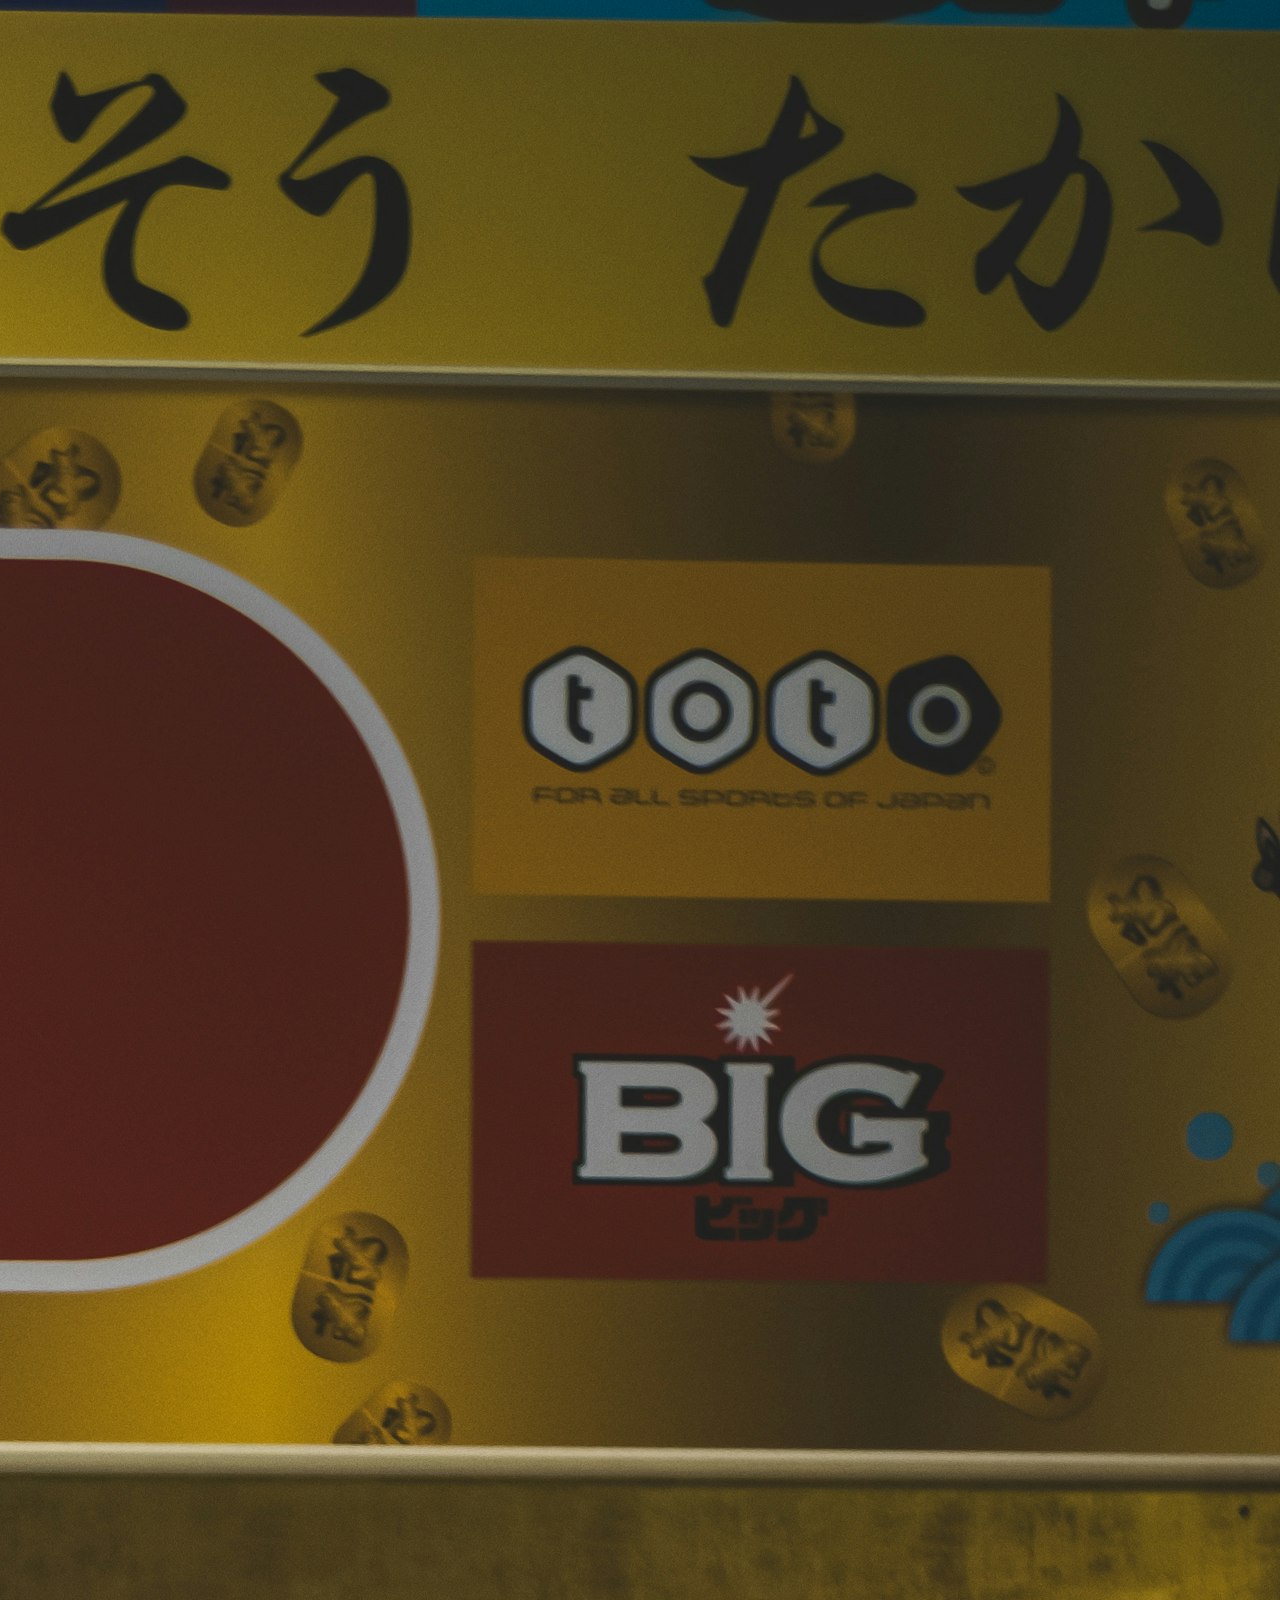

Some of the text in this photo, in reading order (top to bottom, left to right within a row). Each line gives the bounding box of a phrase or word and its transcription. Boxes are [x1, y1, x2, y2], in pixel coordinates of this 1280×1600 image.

[687, 75, 1280, 331] たか
[535, 655, 990, 768] toto
[575, 1056, 930, 1185] BIG
[694, 1194, 828, 1241] ビッグ
